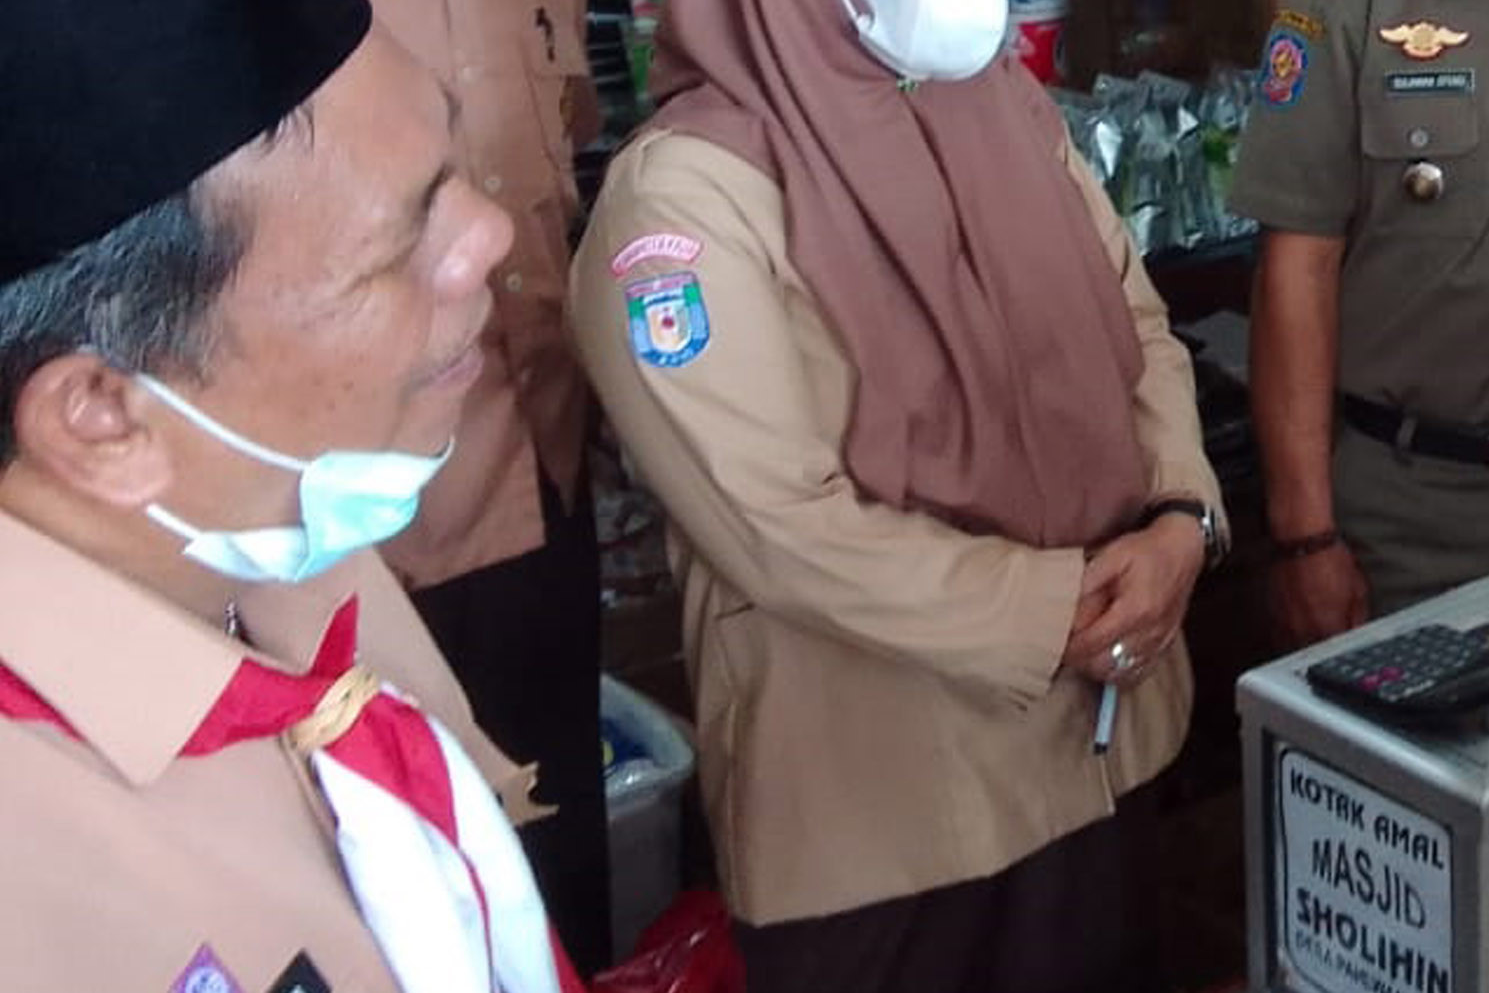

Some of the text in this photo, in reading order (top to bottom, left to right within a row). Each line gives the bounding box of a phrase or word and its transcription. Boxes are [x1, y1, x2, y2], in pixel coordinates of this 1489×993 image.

[1290, 768, 1444, 871] KOTAK AMAL
[1311, 838, 1426, 929] MASJID
[1296, 887, 1449, 993] SHOLIHIN
